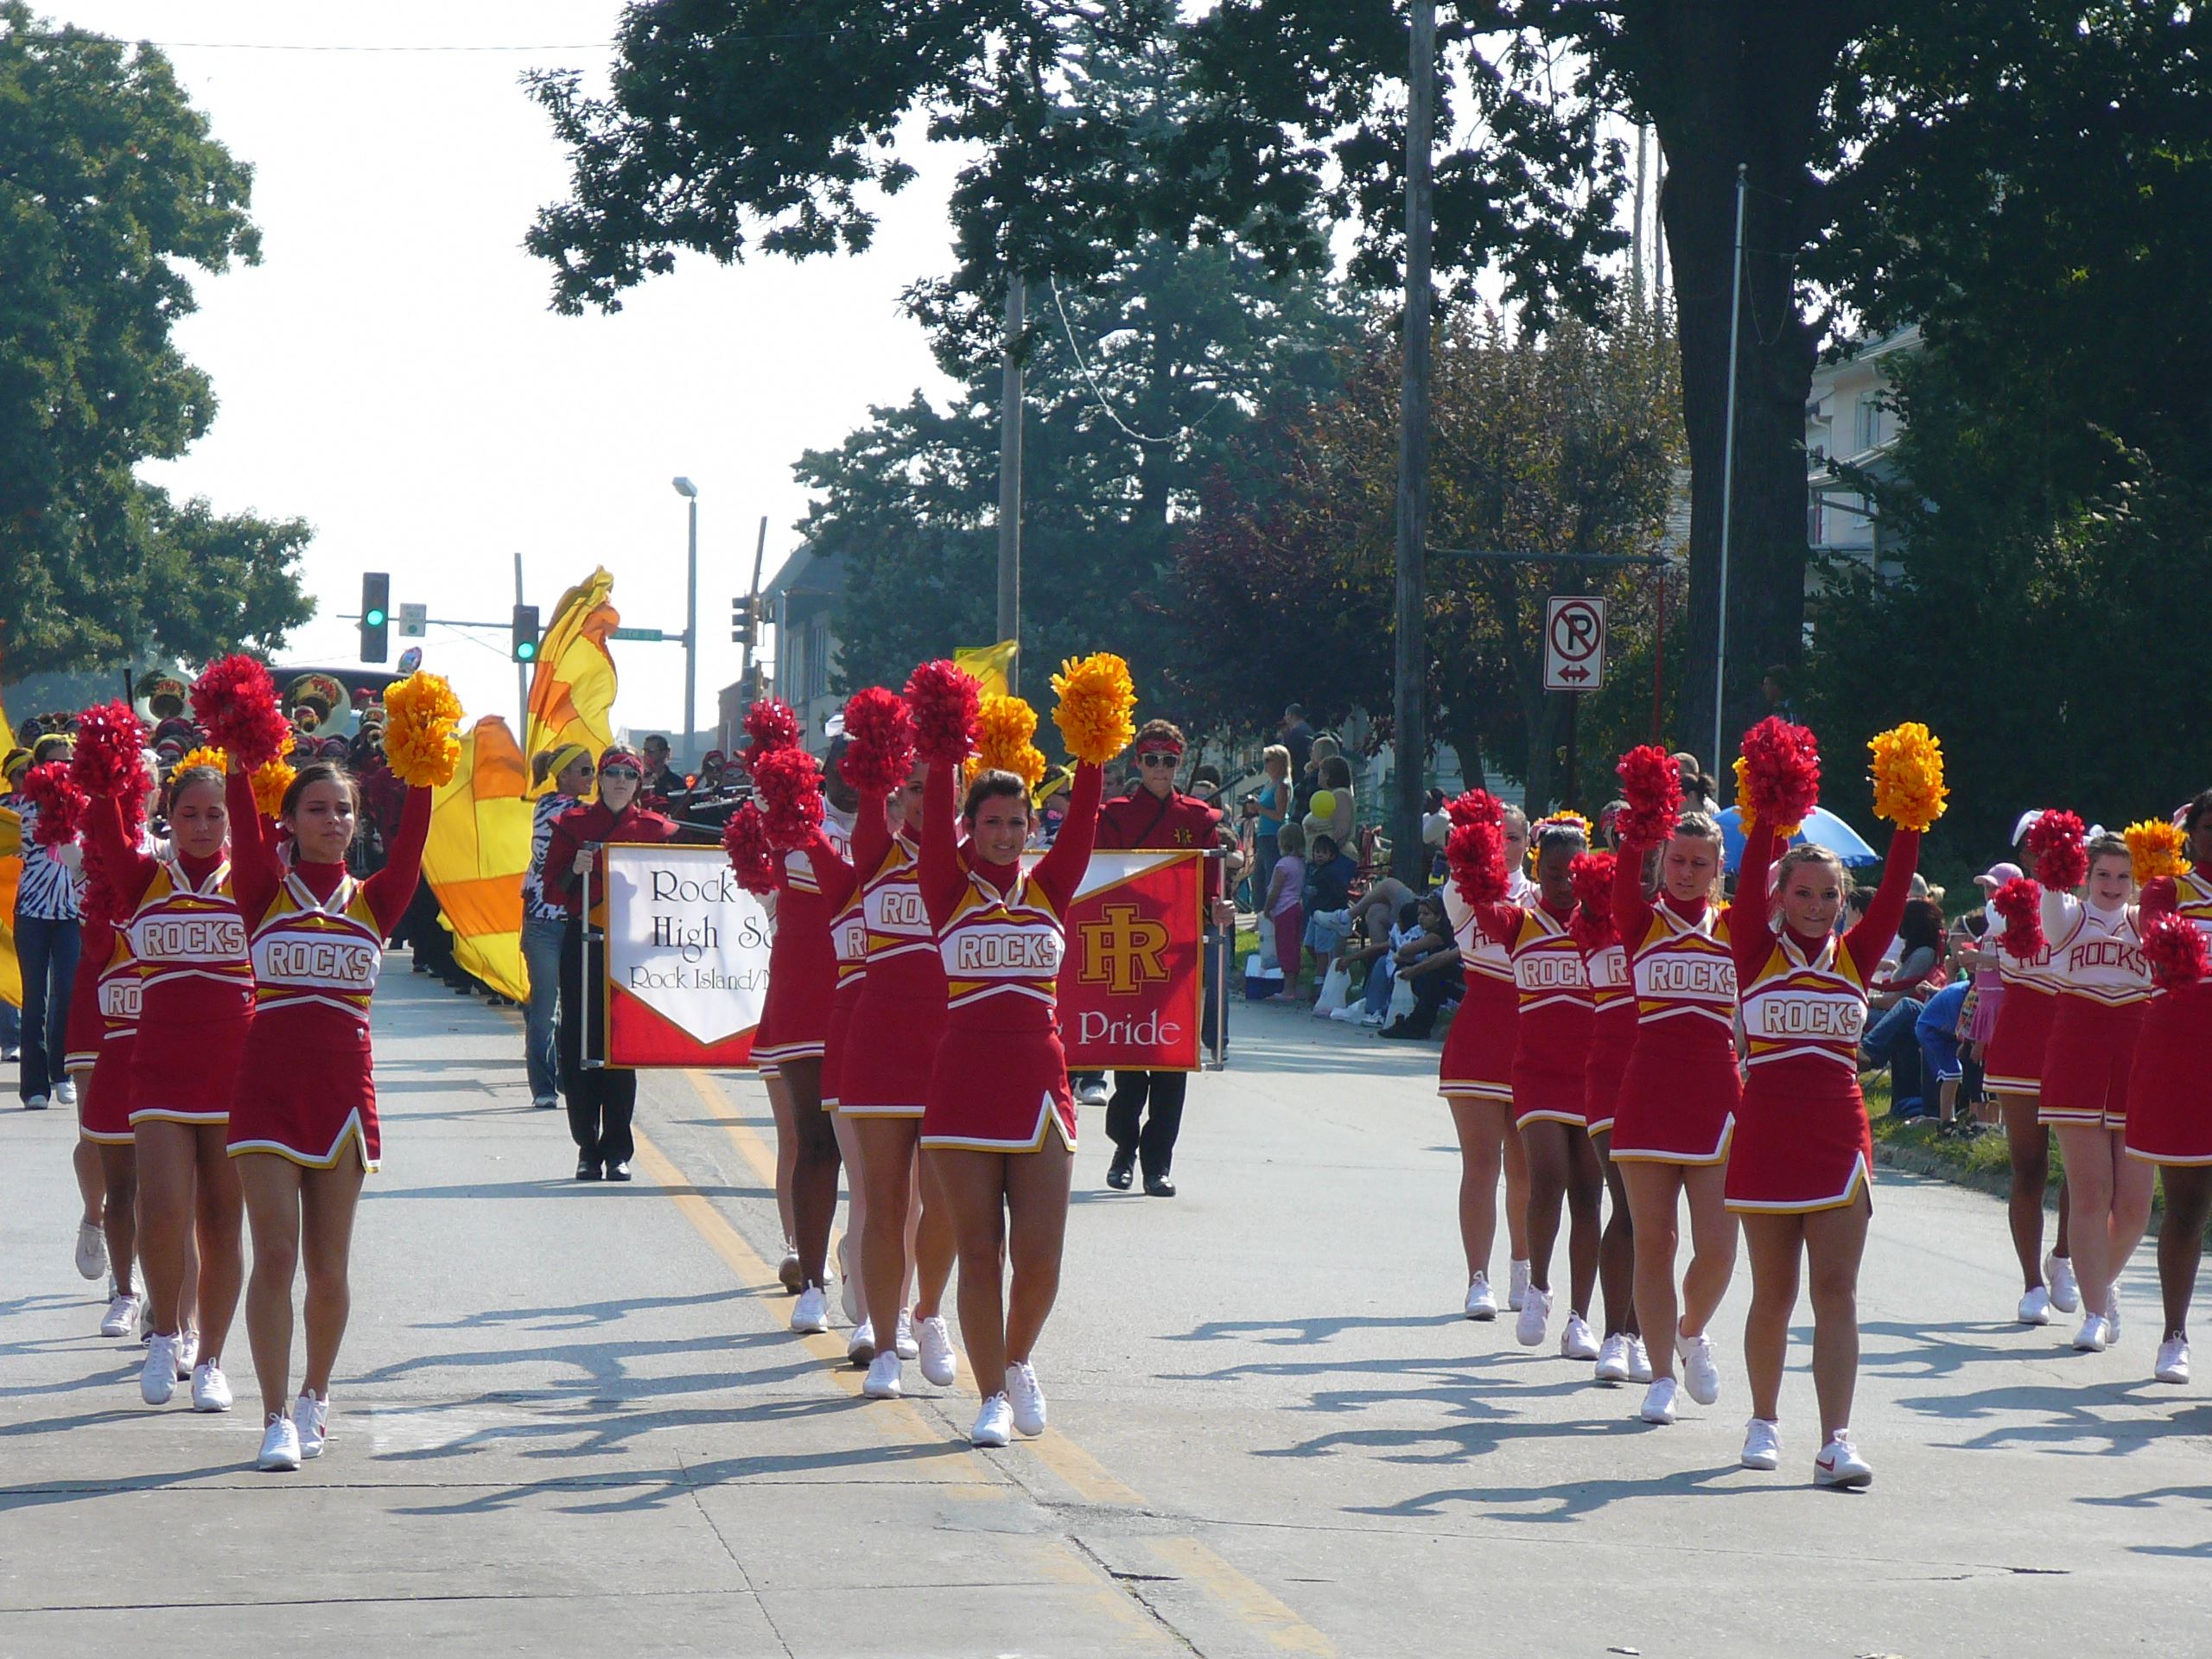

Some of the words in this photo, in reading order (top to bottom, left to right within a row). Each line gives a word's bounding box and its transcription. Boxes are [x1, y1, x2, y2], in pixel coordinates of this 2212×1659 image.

[651, 869, 736, 903] Rock
[143, 921, 245, 956] ROCKS
[652, 914, 720, 963] High
[959, 934, 1057, 969] ROCKS
[268, 941, 372, 982] ROCKS
[629, 965, 689, 989] Rock
[1649, 959, 1738, 995] ROCKS
[2069, 942, 2147, 977] ROCKS
[1078, 1008, 1181, 1046] Pride
[1764, 1000, 1862, 1036] ROCKS
